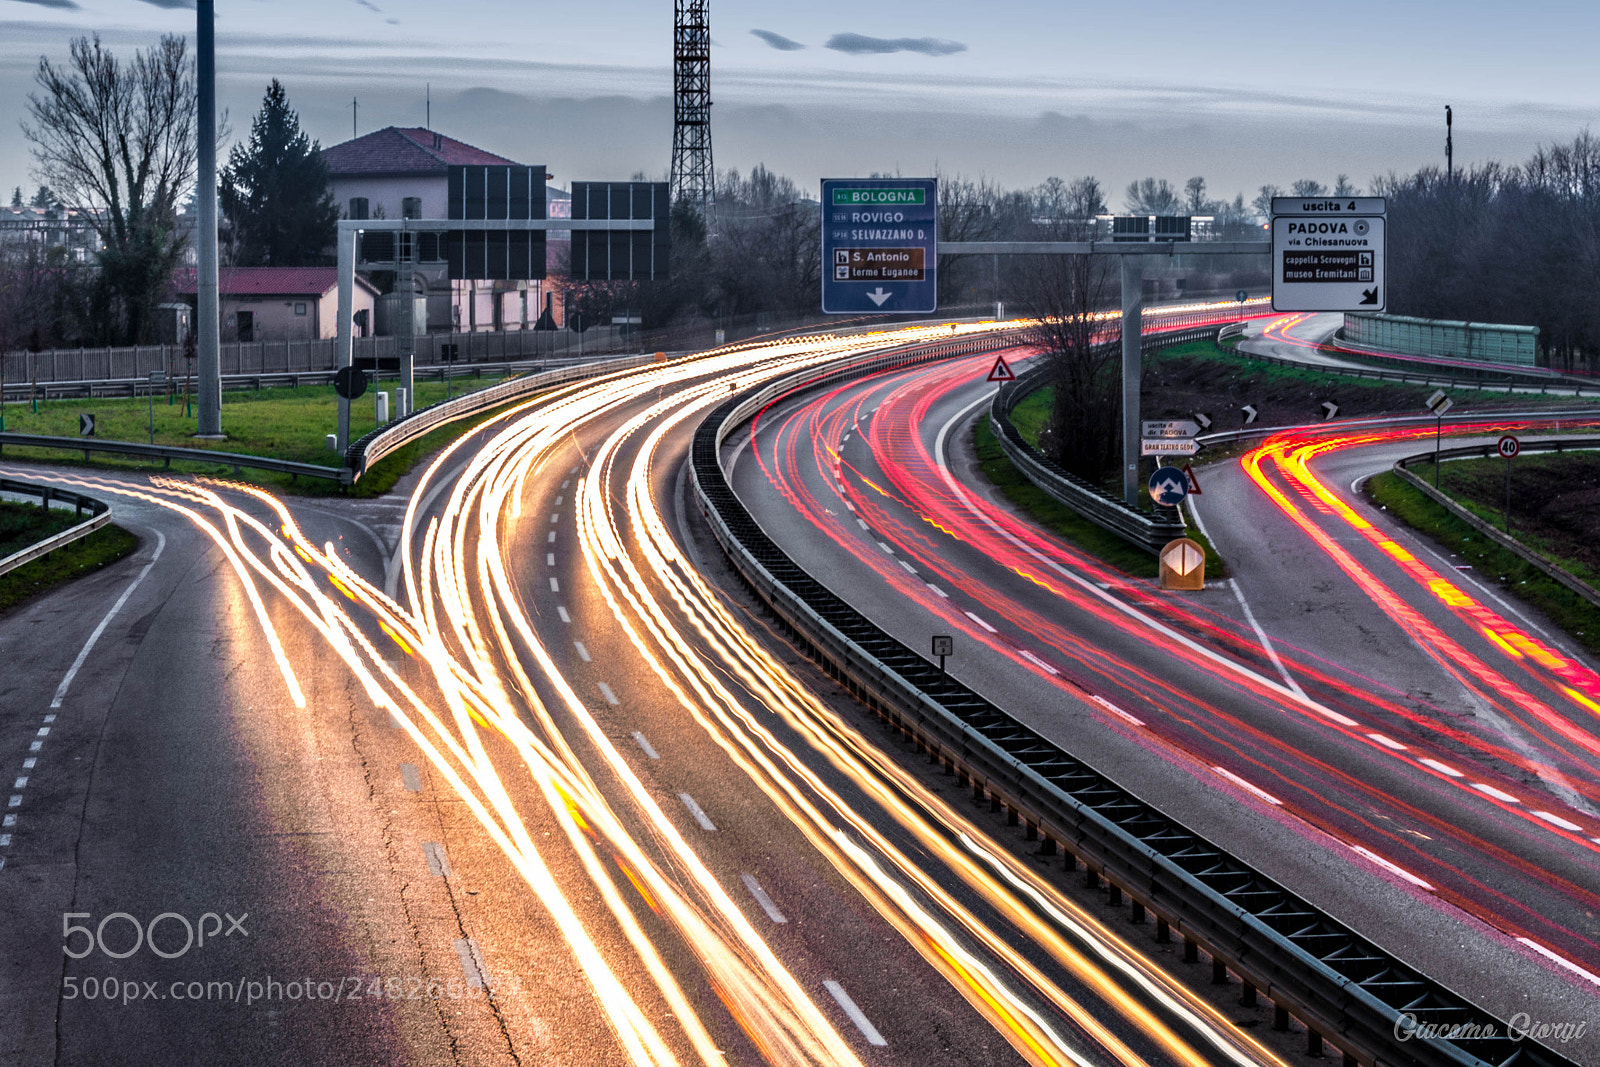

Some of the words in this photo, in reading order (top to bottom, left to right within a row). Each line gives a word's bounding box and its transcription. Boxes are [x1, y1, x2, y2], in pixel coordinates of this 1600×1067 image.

[852, 192, 916, 201] BOLOGNA
[1303, 201, 1340, 211] uscita
[1347, 201, 1356, 211] 4
[852, 212, 904, 222] ROVIGO
[1288, 223, 1348, 234] PADOVA
[852, 230, 914, 240] SELVAZZANO
[918, 230, 927, 240] D.
[1305, 237, 1368, 246] Chiesanuova
[852, 252, 864, 262] S.
[867, 252, 910, 262] Antonio
[1286, 256, 1318, 265] cappella
[1320, 256, 1356, 265] Scrovegni
[852, 267, 879, 276] terme
[882, 267, 919, 278] Euganee
[1286, 270, 1312, 278] museo
[1316, 269, 1356, 278] Eremitani
[1502, 441, 1515, 453] 40
